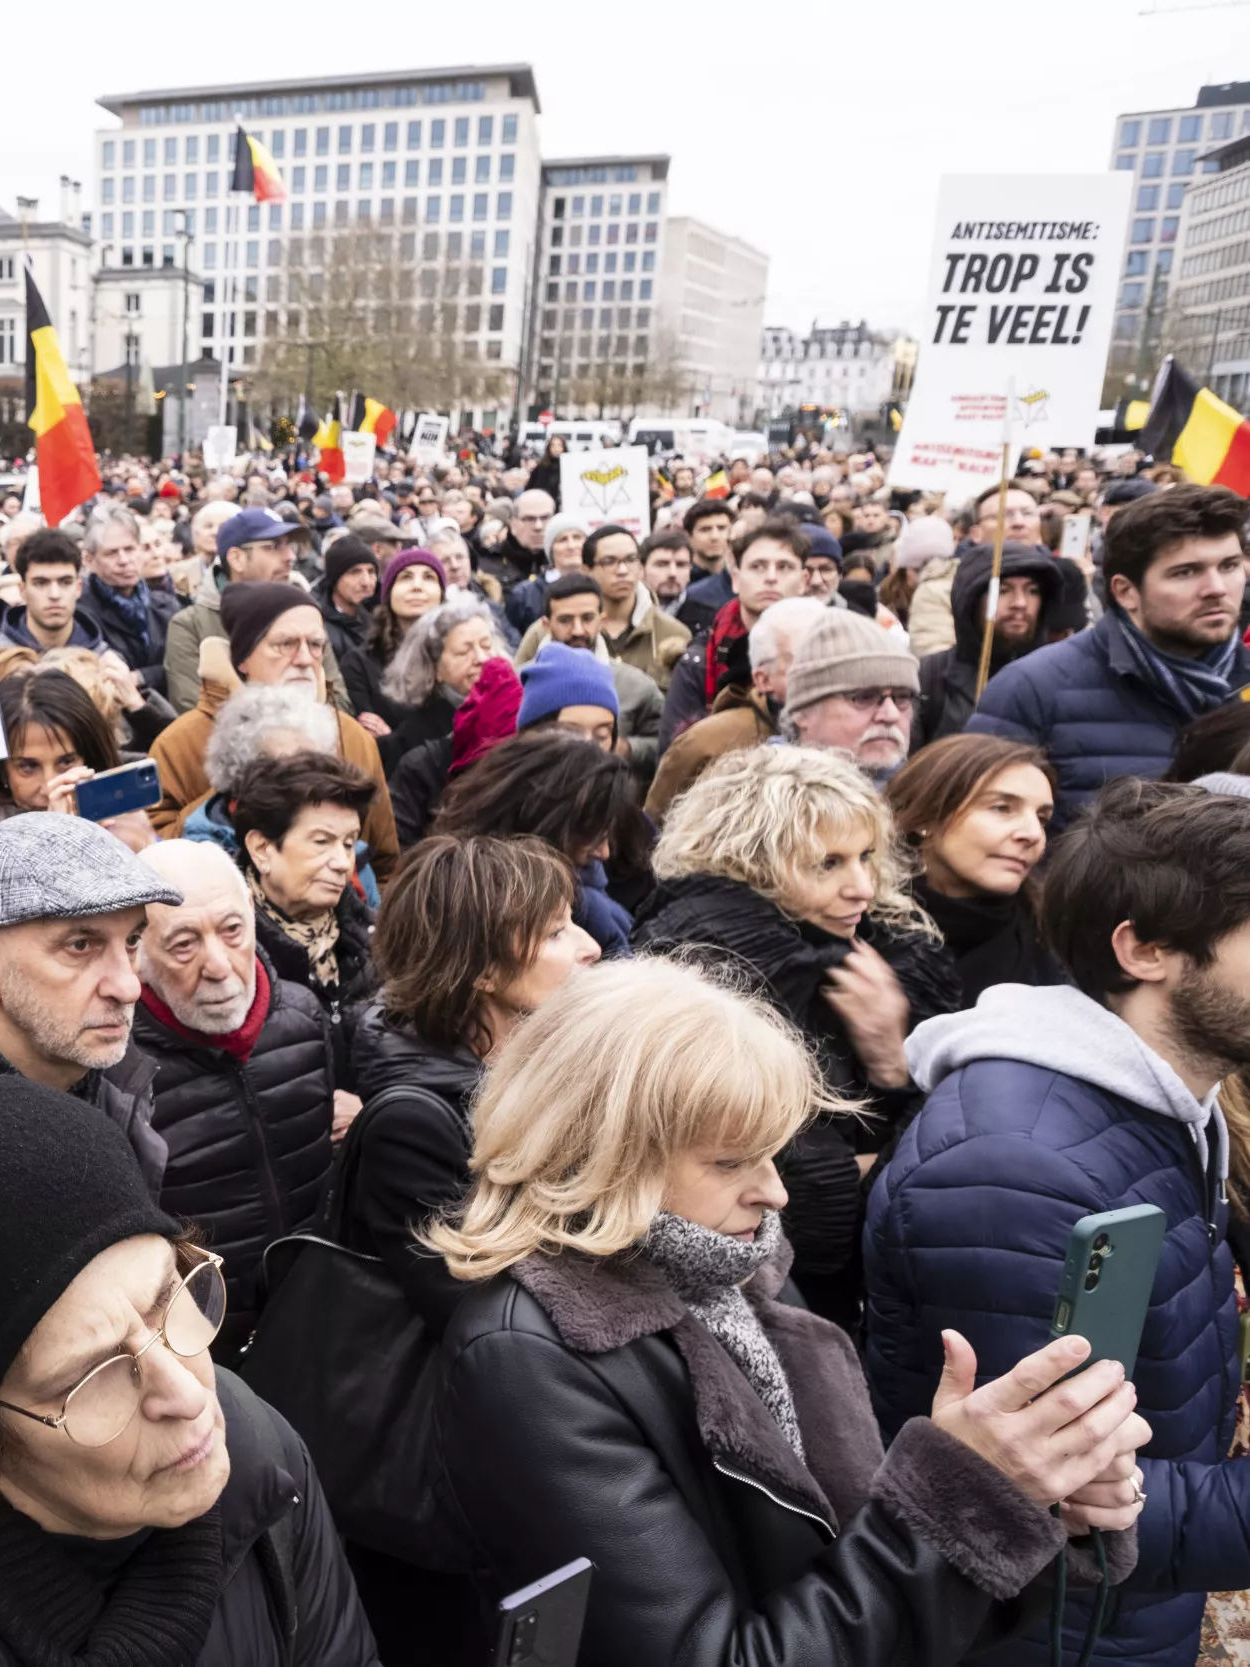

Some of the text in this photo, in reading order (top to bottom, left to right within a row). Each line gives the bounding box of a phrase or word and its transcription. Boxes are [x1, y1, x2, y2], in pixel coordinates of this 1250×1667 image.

[951, 222, 1100, 240] ANTISEMITISME:
[942, 253, 1094, 293] TROP IS
[933, 305, 1092, 344] TE VEEL!
